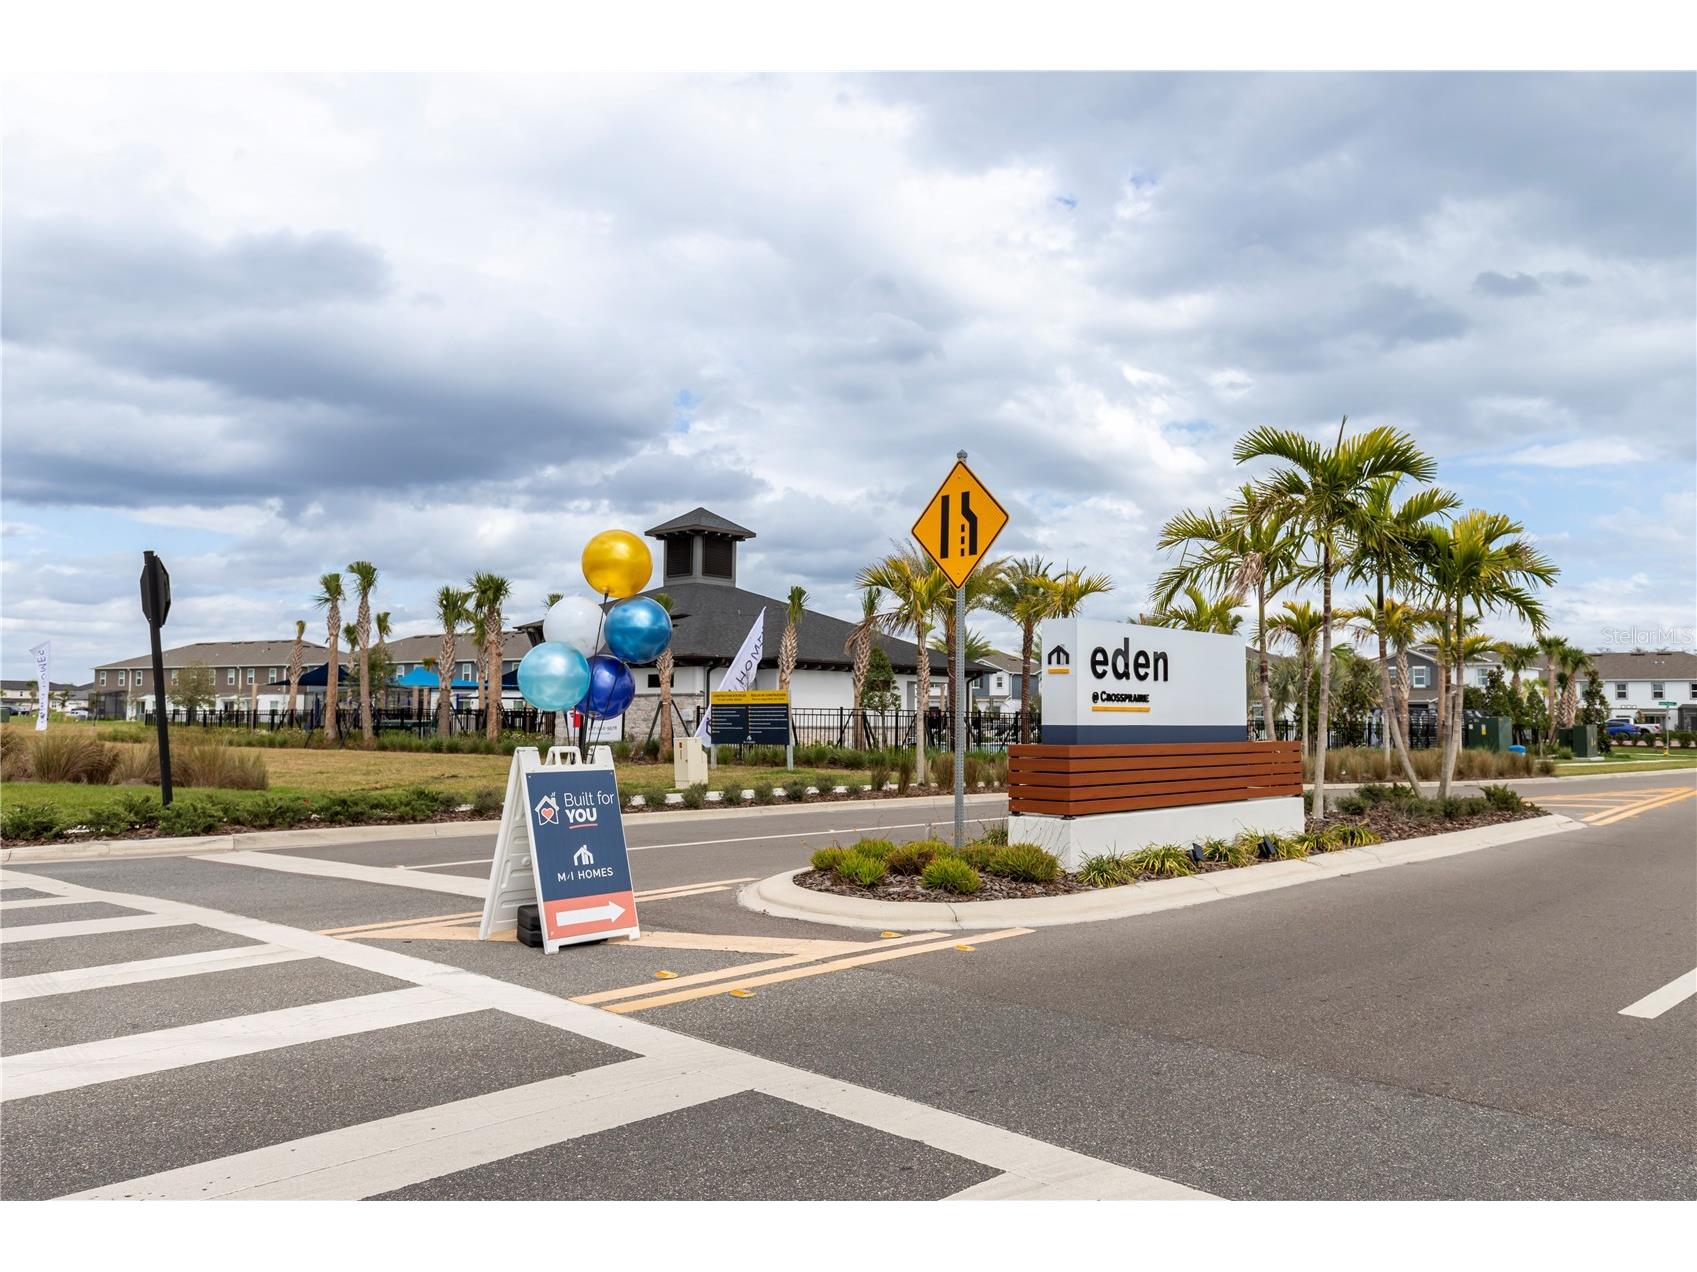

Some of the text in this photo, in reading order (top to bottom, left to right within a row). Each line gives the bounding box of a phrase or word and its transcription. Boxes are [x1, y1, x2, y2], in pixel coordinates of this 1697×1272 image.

[1090, 637, 1169, 682] eden
[564, 790, 615, 807] Built for
[565, 807, 598, 823] YOU
[578, 866, 614, 880] HOMES
